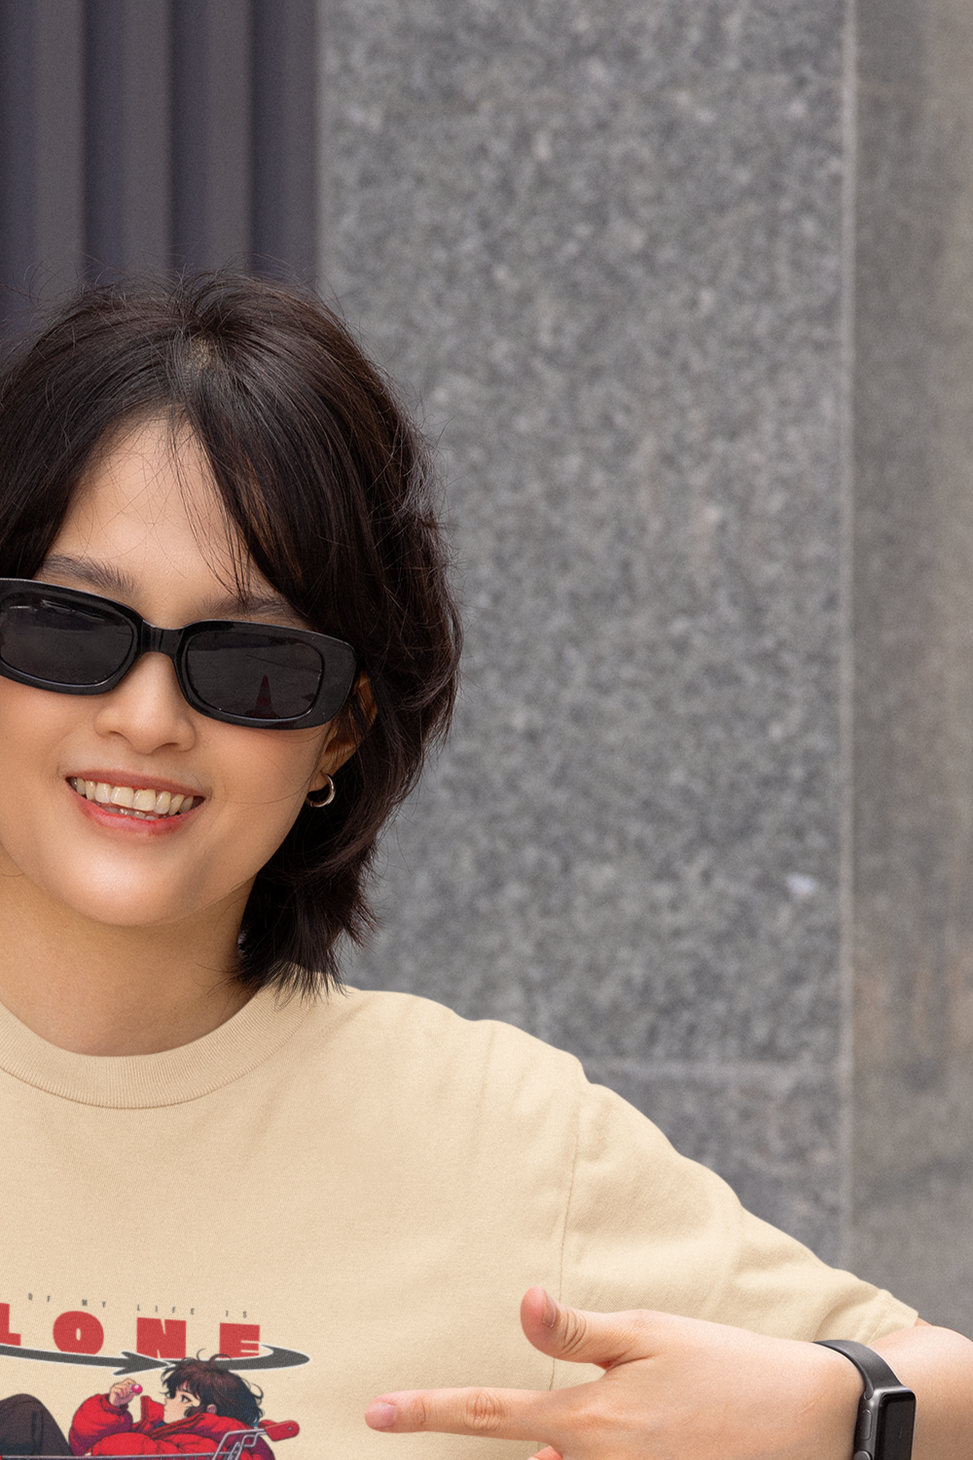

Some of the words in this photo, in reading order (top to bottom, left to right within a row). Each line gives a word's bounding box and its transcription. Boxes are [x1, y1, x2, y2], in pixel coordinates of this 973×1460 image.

[28, 1292, 51, 1303] OF
[81, 1299, 106, 1309] MY
[136, 1304, 195, 1315] LIFE
[225, 1310, 248, 1319] IS
